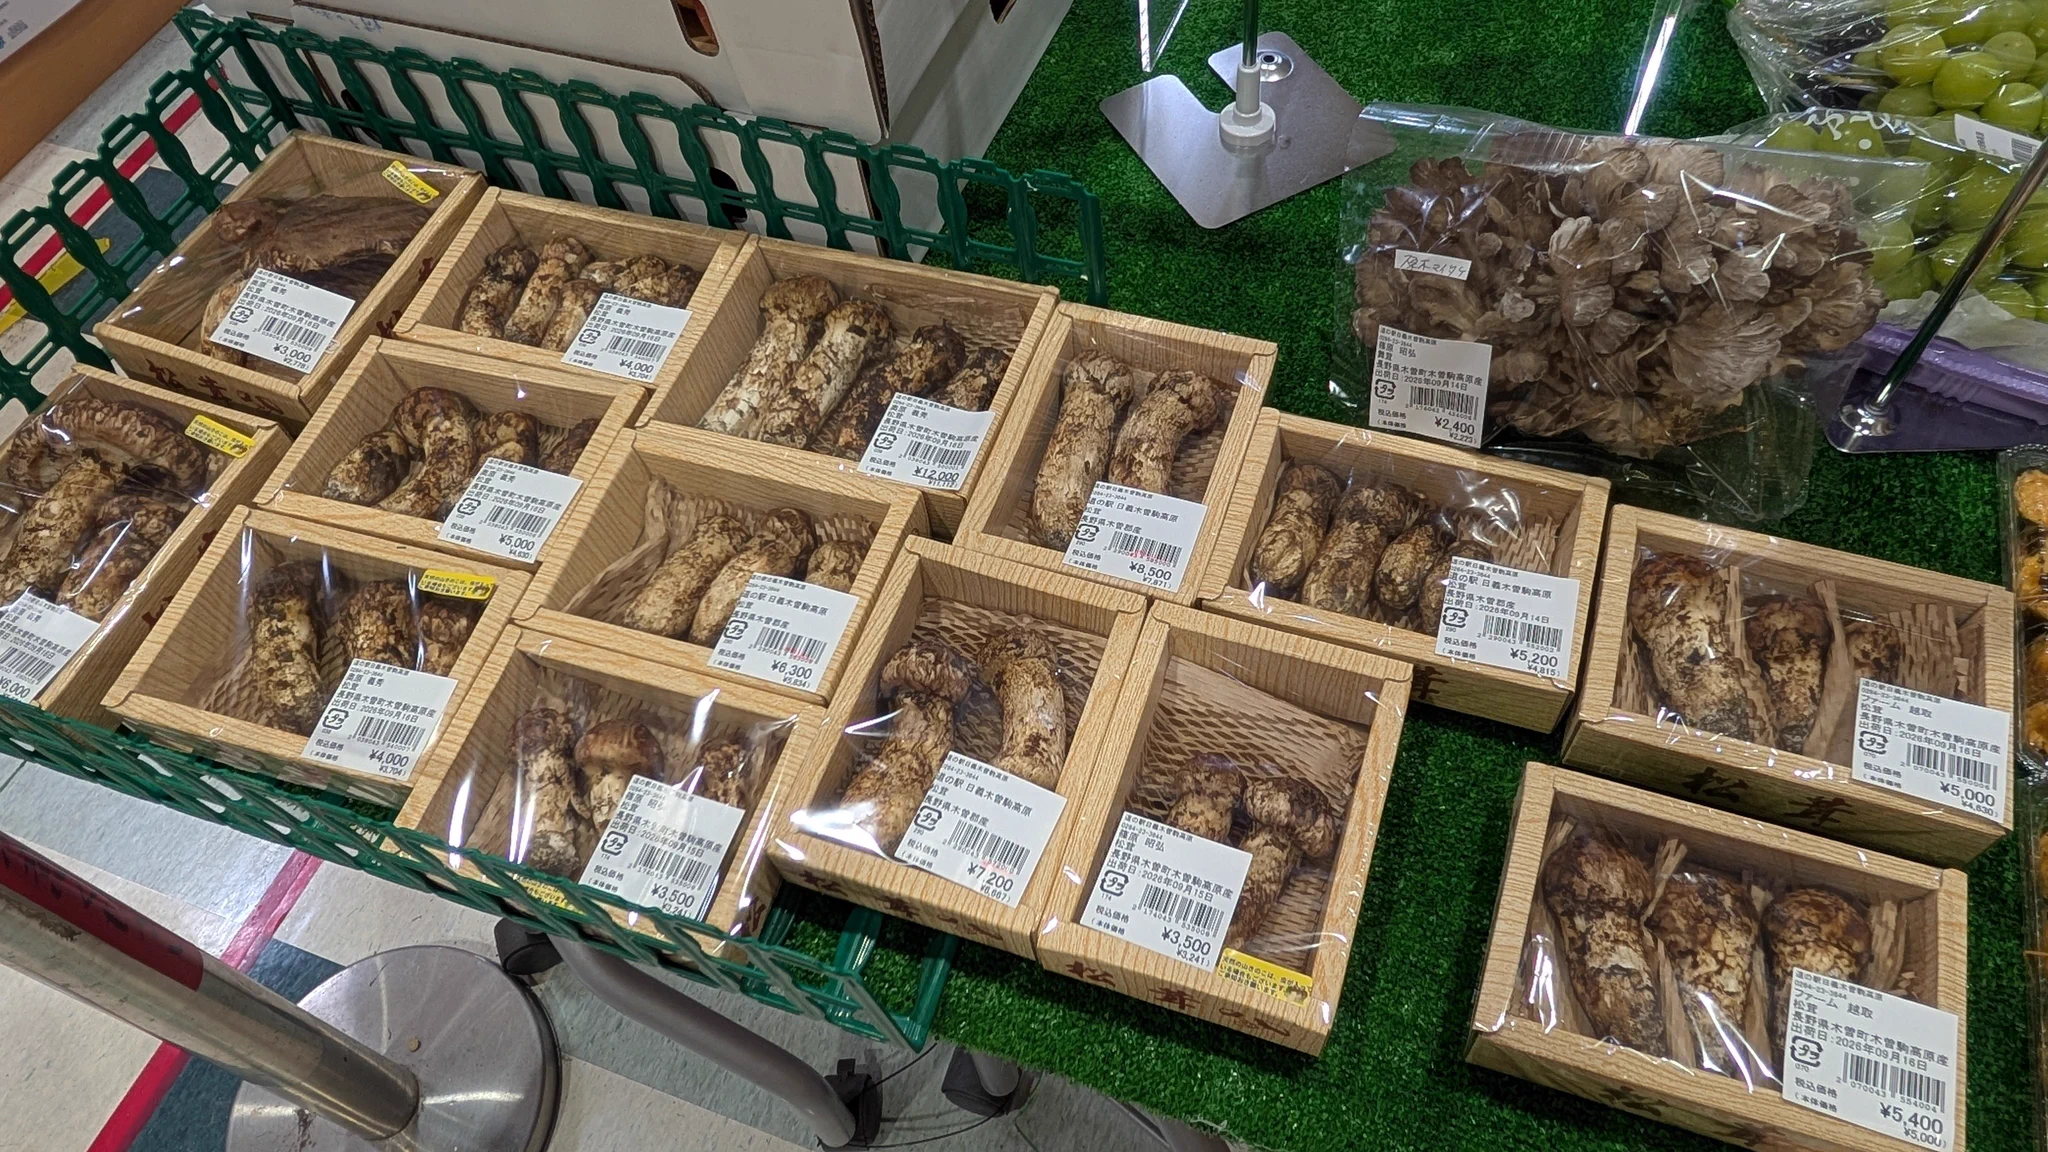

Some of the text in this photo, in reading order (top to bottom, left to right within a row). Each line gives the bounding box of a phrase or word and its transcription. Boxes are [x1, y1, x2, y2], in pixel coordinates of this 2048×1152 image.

[246, 285, 262, 294] 松茸
[593, 309, 608, 317] 松茸
[273, 342, 311, 362] ¥3,000
[619, 358, 654, 373] ¥4,000
[886, 411, 903, 419] 松茸
[1377, 408, 1406, 419] 税込価格
[1434, 415, 1474, 435] ¥2,400
[475, 475, 492, 484] 松茸
[911, 465, 959, 483] ¥12,000
[1083, 504, 1101, 514] 松茸
[1086, 494, 1114, 508] 道の駅
[498, 533, 535, 551] ¥5,000
[1071, 548, 1101, 560] 税込価格
[1128, 561, 1171, 580] ¥8,500
[1446, 579, 1467, 590] 松茸
[1447, 571, 1551, 599] 道の駅 日義木曽駒高原
[735, 598, 753, 609] 松茸
[740, 589, 767, 600] 道の駅
[1444, 587, 1515, 609] 長野県木曽郡産
[1443, 636, 1477, 649] 税込価格
[1510, 647, 1558, 667] ¥5,200
[770, 659, 812, 679] ¥6,300
[341, 681, 359, 691] 松茸
[1860, 702, 1882, 714] 松茸
[1861, 693, 1932, 718] ファーム 越取
[1859, 709, 2000, 754] 長野県木曽町木曽駒高原産
[368, 748, 409, 767] ¥4,000
[1863, 761, 1901, 778] 税込価格
[929, 783, 948, 796] 松茸
[934, 769, 1032, 816] 道の駅 日義木曽駒高原
[1682, 767, 1856, 828] 松茸
[1939, 780, 1995, 807] ¥5,000
[620, 800, 639, 812] 松茸
[922, 793, 989, 827] 長野県木曽郡産
[1114, 837, 1135, 852] 松茸
[1118, 828, 1164, 852] 篠原 昭弘
[593, 864, 623, 881] 税込価格
[967, 861, 1013, 892] ¥7,200
[1108, 848, 1233, 899] 長野県木曽町木曽駒高原産
[650, 883, 695, 908] ¥3,500
[1095, 904, 1129, 923] 税込価格
[1161, 926, 1211, 955] ¥3,500
[1066, 961, 1202, 1010] 松茸
[1793, 998, 1817, 1014] 松茸
[1794, 987, 1873, 1019] ファーム 越取
[1792, 1010, 1948, 1067] 長野県木曽町木曽駒高原産
[1795, 1077, 1837, 1098] 税込価格
[1879, 1101, 1943, 1134] ¥5,400
